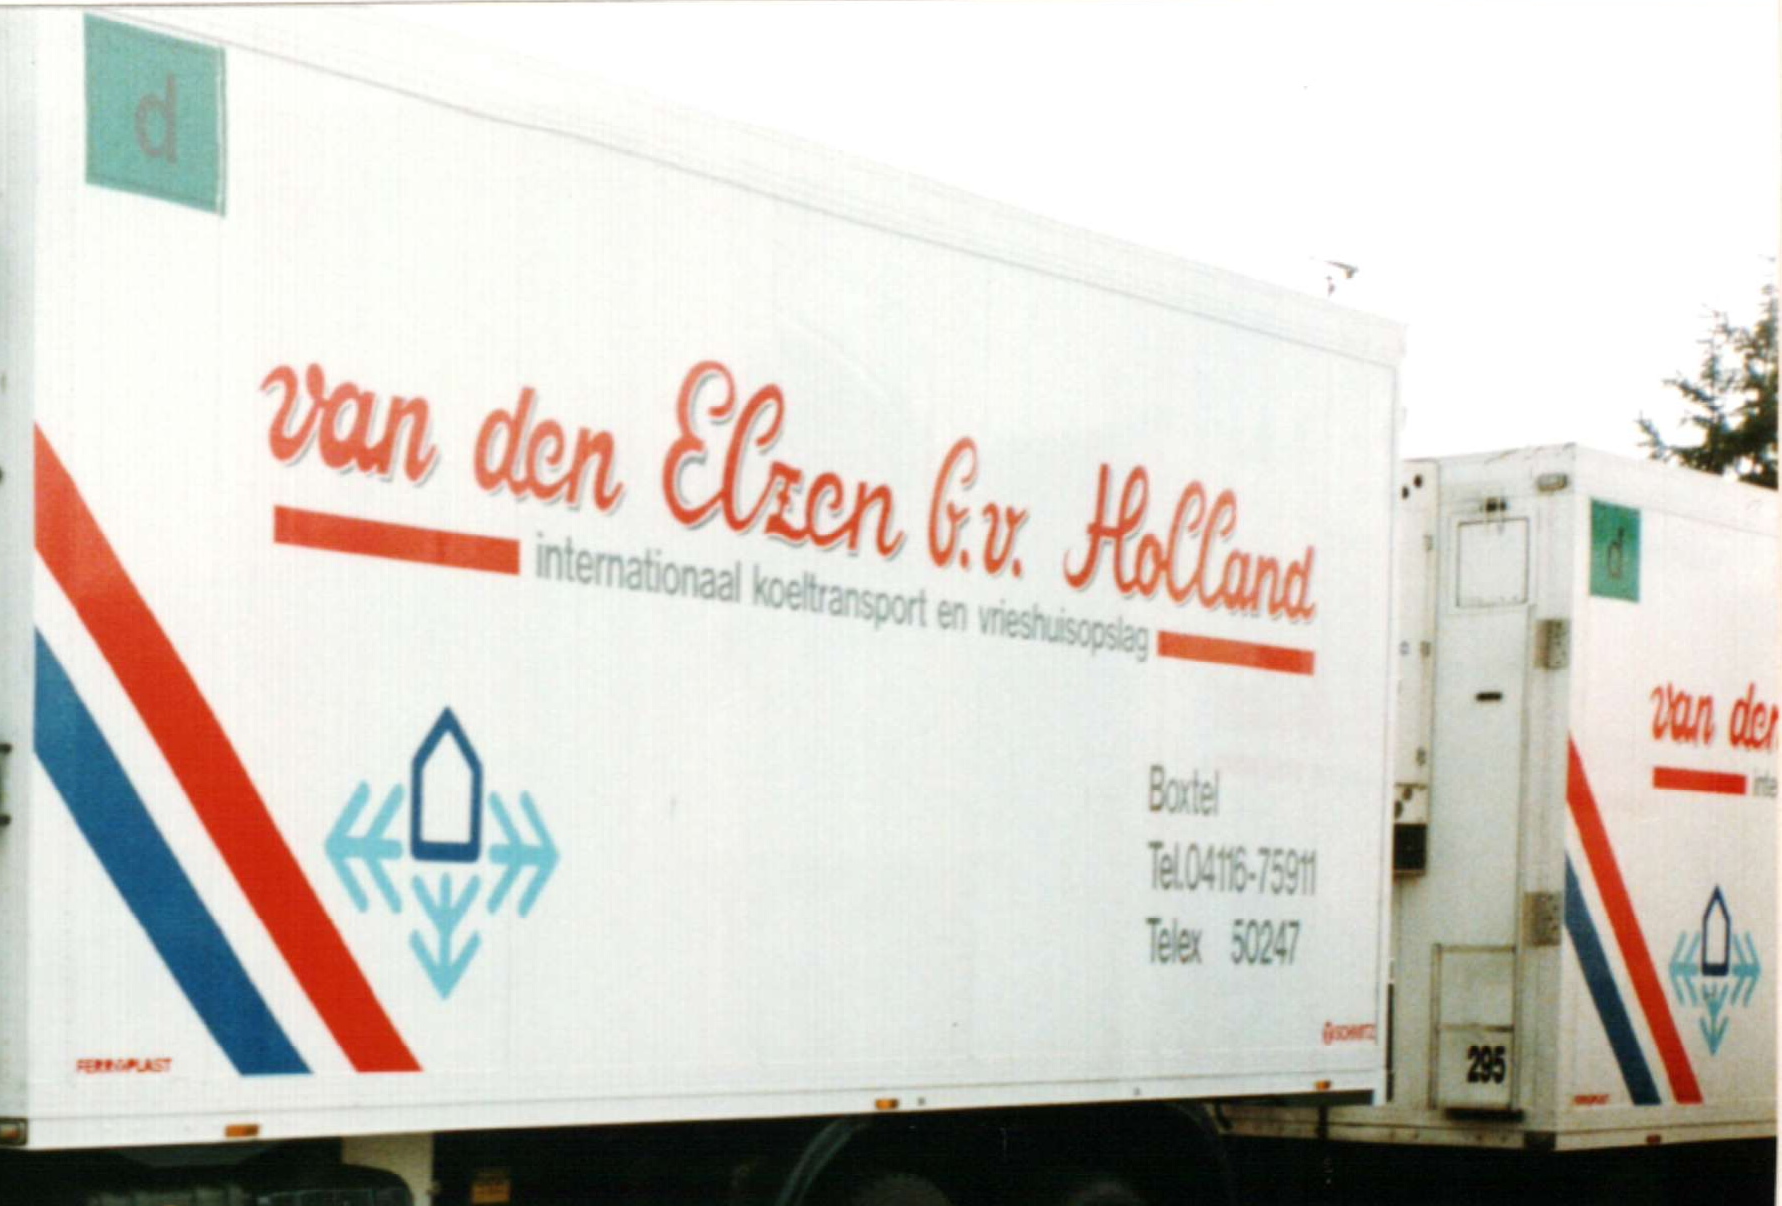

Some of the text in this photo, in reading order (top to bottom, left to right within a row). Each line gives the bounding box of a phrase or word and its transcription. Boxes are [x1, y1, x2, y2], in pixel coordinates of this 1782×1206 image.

[134, 72, 178, 163] d
[260, 362, 439, 484] van
[474, 387, 625, 514] den
[661, 359, 905, 562] Elzen
[1063, 463, 1316, 622] Holland
[535, 530, 1149, 663] internationaal koeltransport en vrieshuisopslag
[1649, 680, 1717, 747] van
[1148, 763, 1220, 817] Boxtel
[1145, 916, 1302, 968] Telex 50247
[1465, 1044, 1508, 1085] 295
